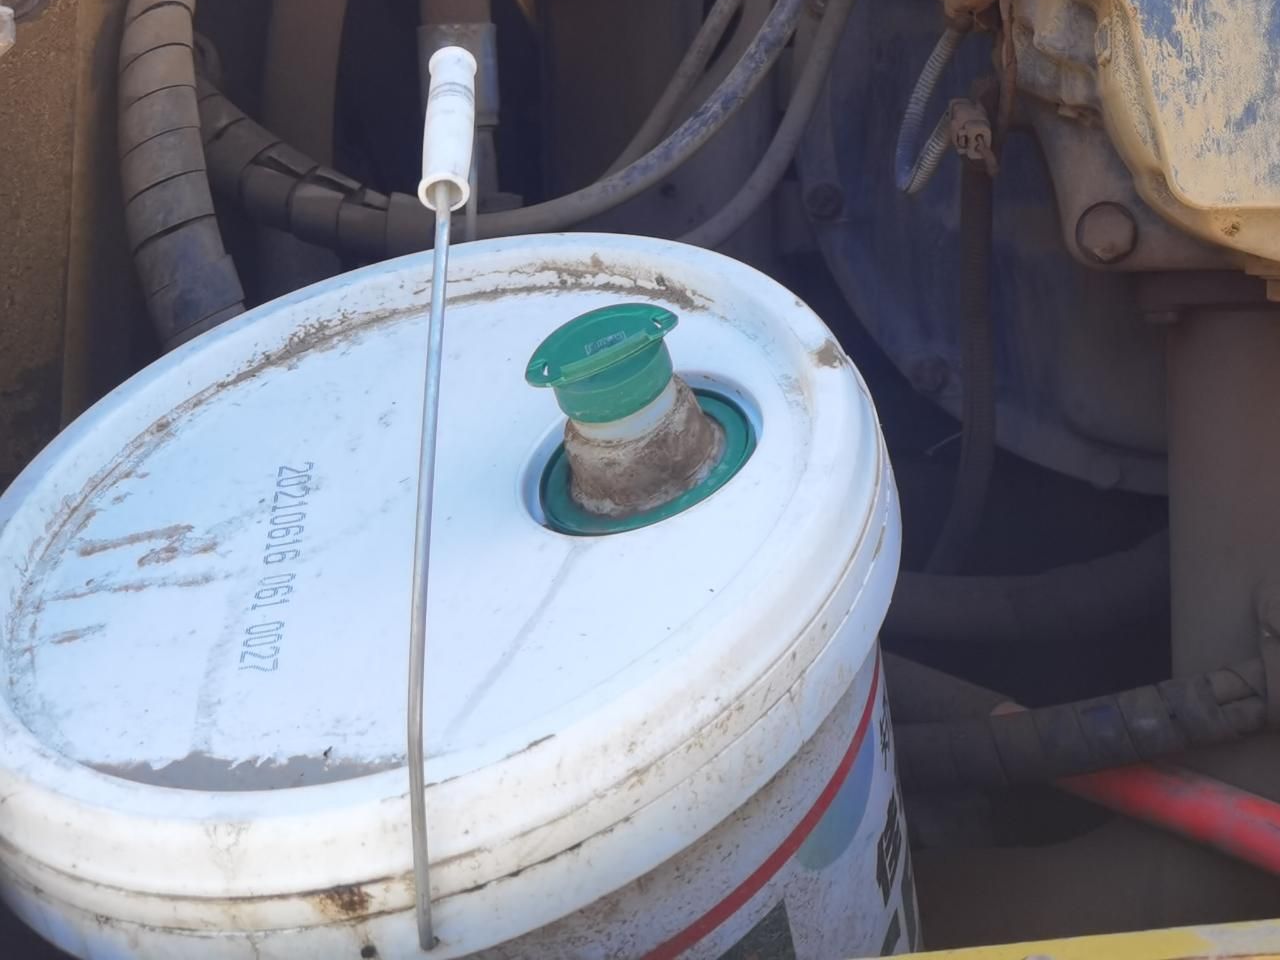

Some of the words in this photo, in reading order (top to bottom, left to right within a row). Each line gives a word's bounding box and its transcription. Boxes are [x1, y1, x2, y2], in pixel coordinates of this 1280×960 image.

[263, 461, 315, 565] 20210616
[250, 572, 297, 611] 061
[238, 620, 285, 672] 0027
